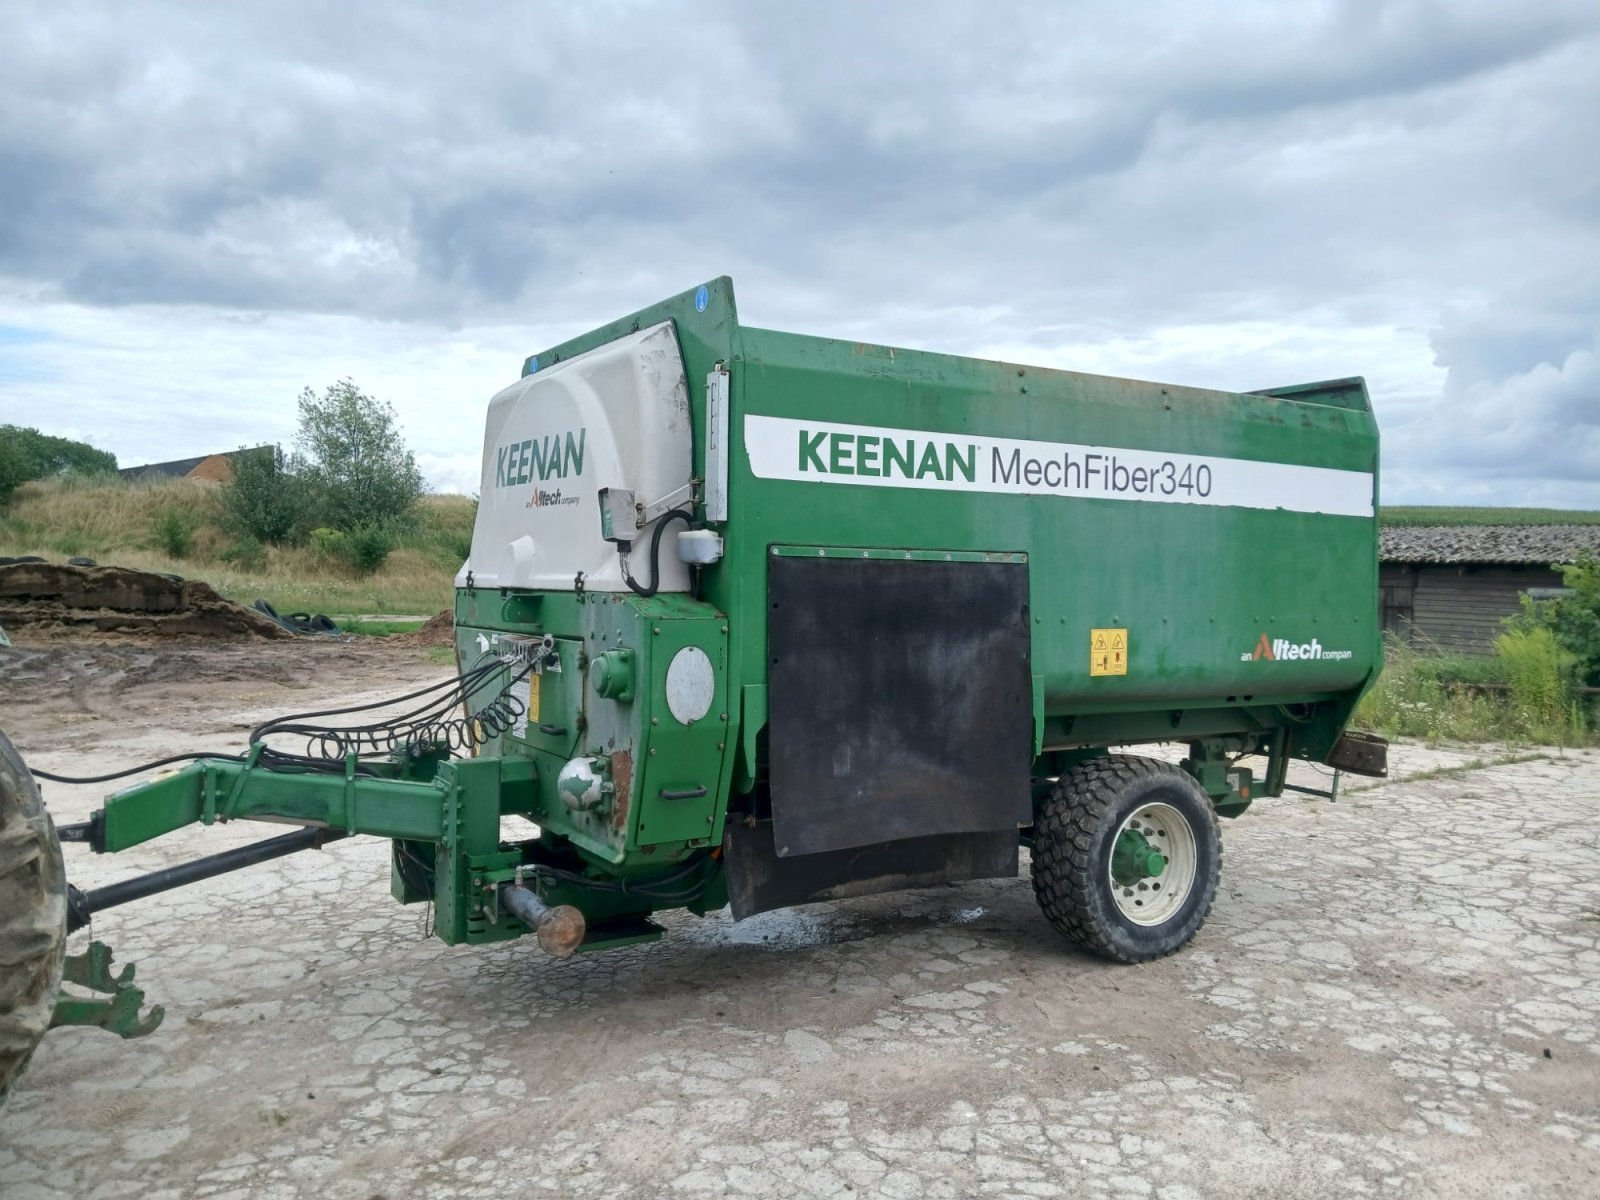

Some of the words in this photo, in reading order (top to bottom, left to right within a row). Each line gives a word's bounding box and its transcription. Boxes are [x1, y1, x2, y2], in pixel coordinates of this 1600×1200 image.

[496, 428, 586, 488] KEENAN
[799, 430, 976, 482] KEENAN
[992, 446, 1212, 497] MechFiber340
[530, 486, 562, 508] Alltech
[1241, 652, 1252, 661] an
[1252, 633, 1322, 661] Alltech
[1322, 650, 1352, 661] compan
